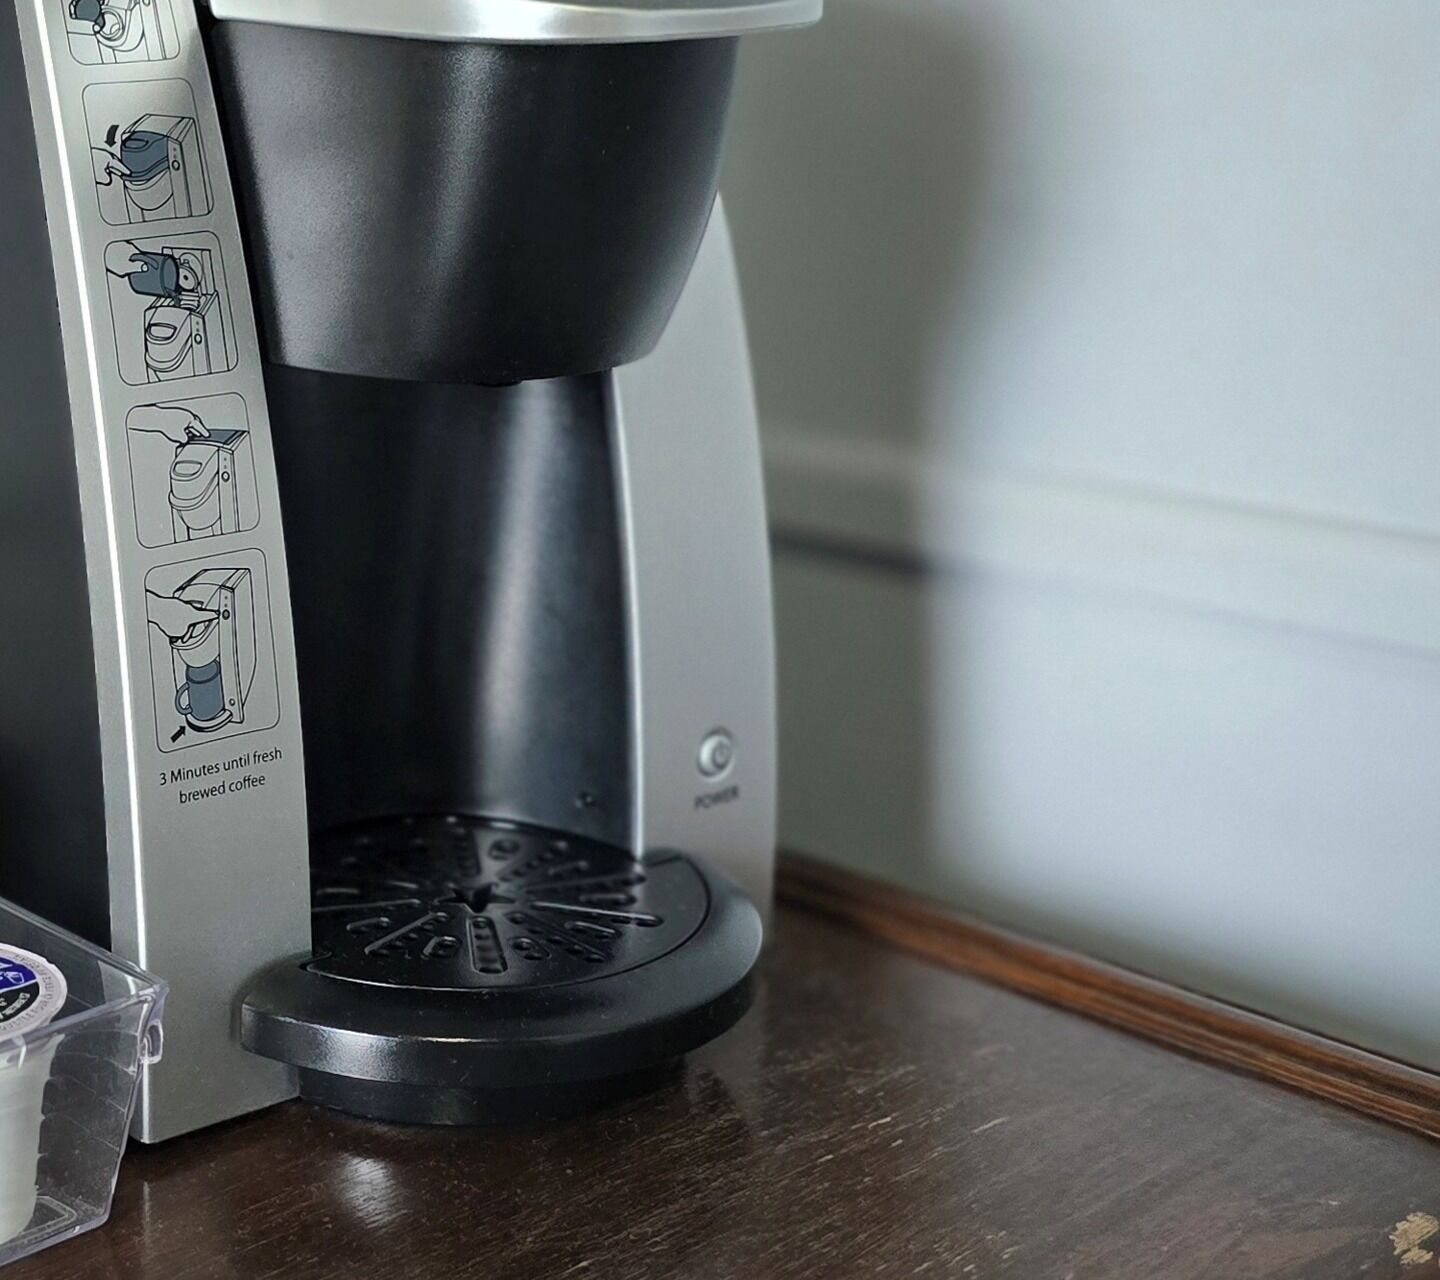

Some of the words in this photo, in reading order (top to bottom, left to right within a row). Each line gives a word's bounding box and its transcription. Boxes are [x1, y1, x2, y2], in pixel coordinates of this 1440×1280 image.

[159, 772, 167, 786] 3
[170, 762, 220, 783] Minutes
[223, 752, 250, 772] until
[253, 746, 283, 765] fresh
[179, 781, 226, 804] brewed
[228, 774, 266, 793] coffee
